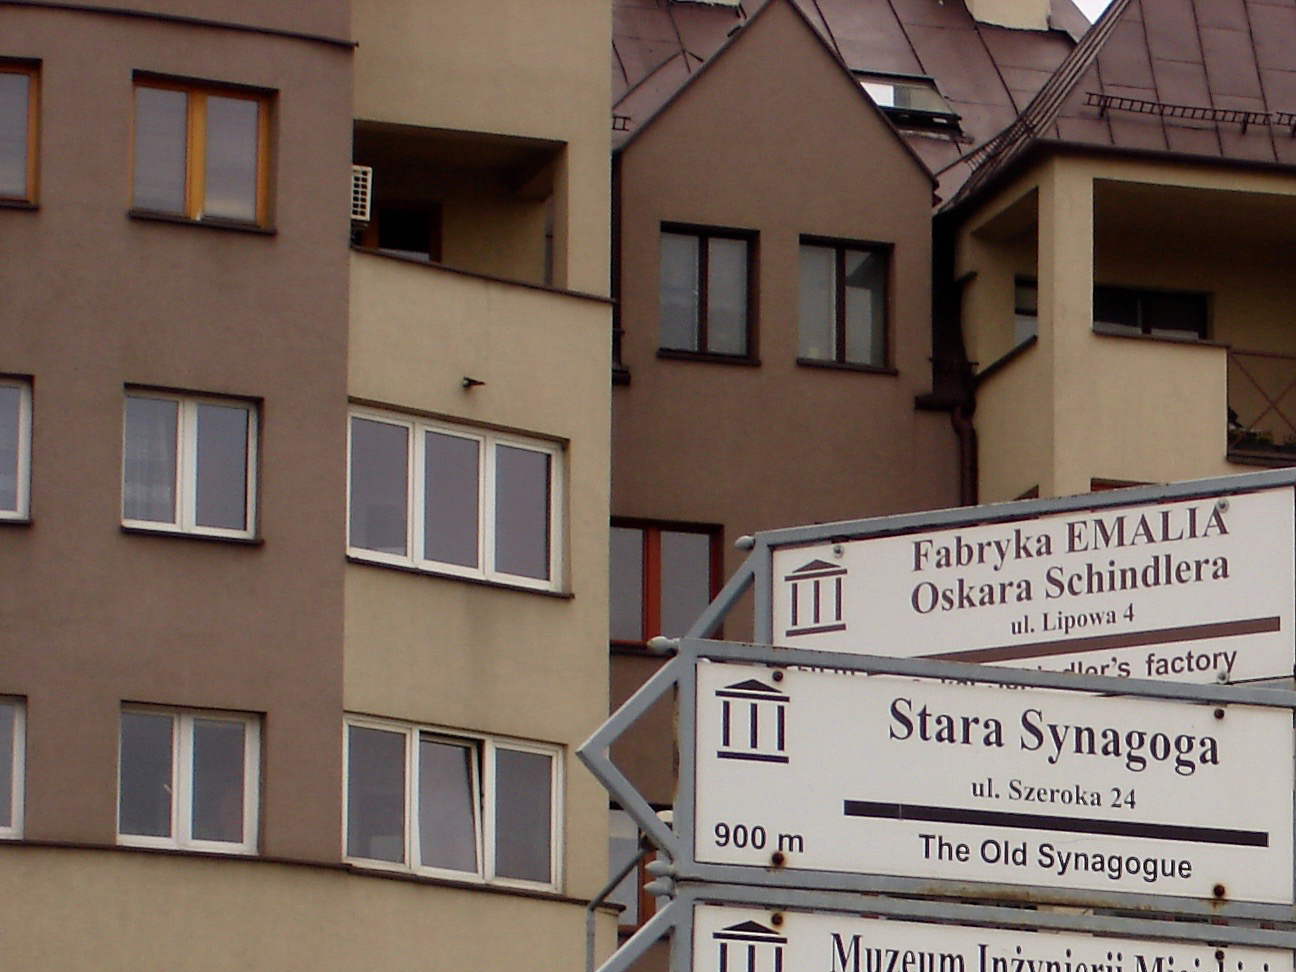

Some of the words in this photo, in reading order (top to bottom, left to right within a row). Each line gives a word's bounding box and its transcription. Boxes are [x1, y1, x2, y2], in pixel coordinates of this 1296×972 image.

[912, 529, 1052, 571] Fabryka
[1066, 505, 1229, 553] EMALIA
[912, 578, 1032, 614] Oskara
[1046, 554, 1229, 598] Schindlera
[1012, 615, 1034, 635] ul.
[1044, 611, 1116, 634] Lipowa
[1124, 603, 1134, 621] 4
[1146, 651, 1237, 680] factory
[890, 698, 1003, 747] Stara
[1020, 708, 1220, 774] Synagoga
[973, 778, 999, 798] ul.
[1009, 780, 1101, 806] Szeroka
[1111, 788, 1135, 809] 24
[715, 823, 766, 849] 900
[777, 834, 804, 854] m
[919, 834, 969, 862] The
[981, 840, 1026, 866] Old
[1038, 844, 1192, 882] Synagogue
